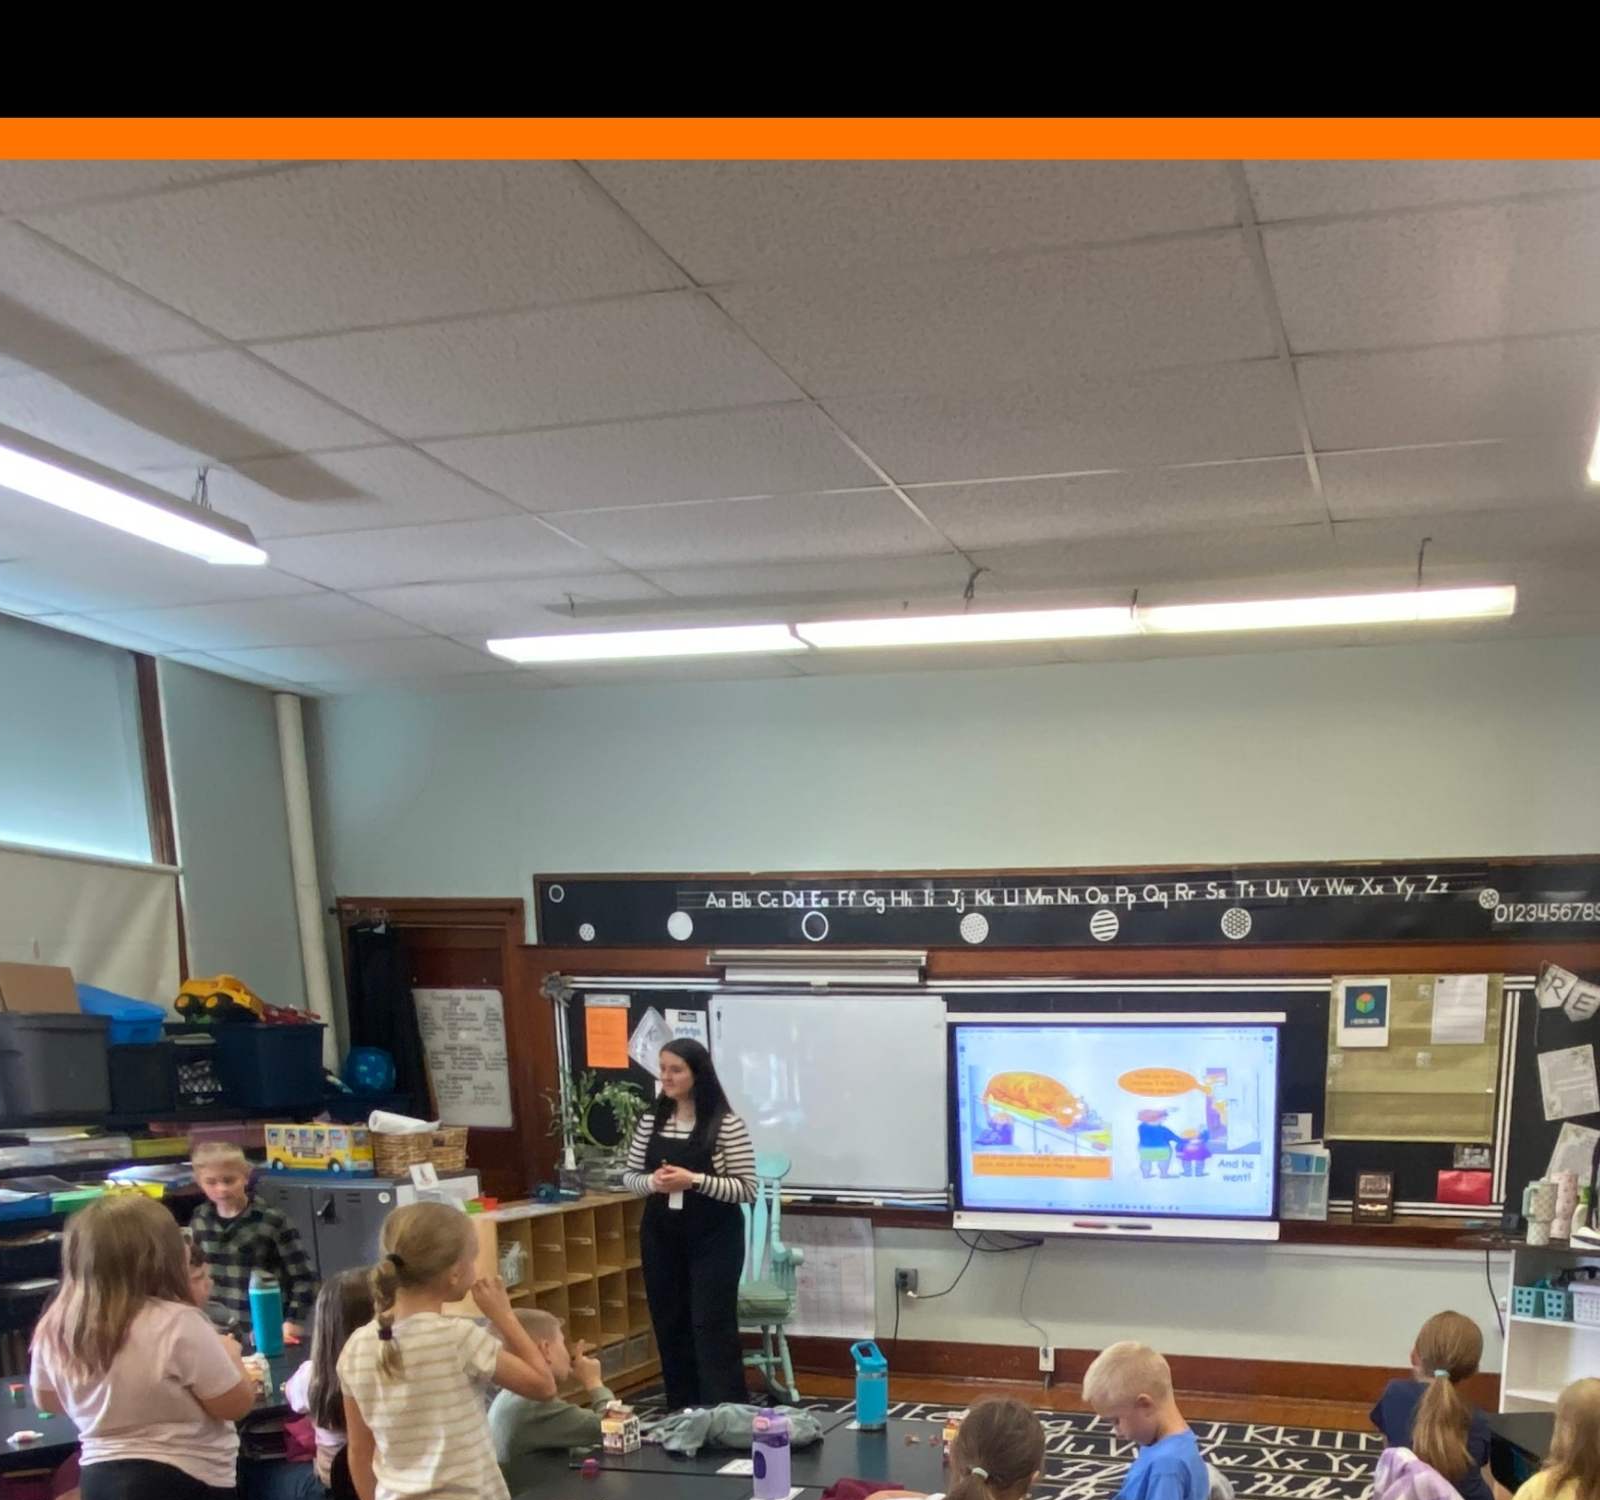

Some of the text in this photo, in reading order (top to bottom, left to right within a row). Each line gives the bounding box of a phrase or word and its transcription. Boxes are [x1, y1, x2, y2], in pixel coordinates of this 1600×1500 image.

[705, 875, 1448, 914] Aa Bb Cc Dd Ee Ff Gg Hh Ii Jj Kk Ll Mm Nn Oo Pp Qq Rr Ss Tt Uu Vv Ww Xx Yy Zz
[1218, 1160, 1254, 1169] And he
